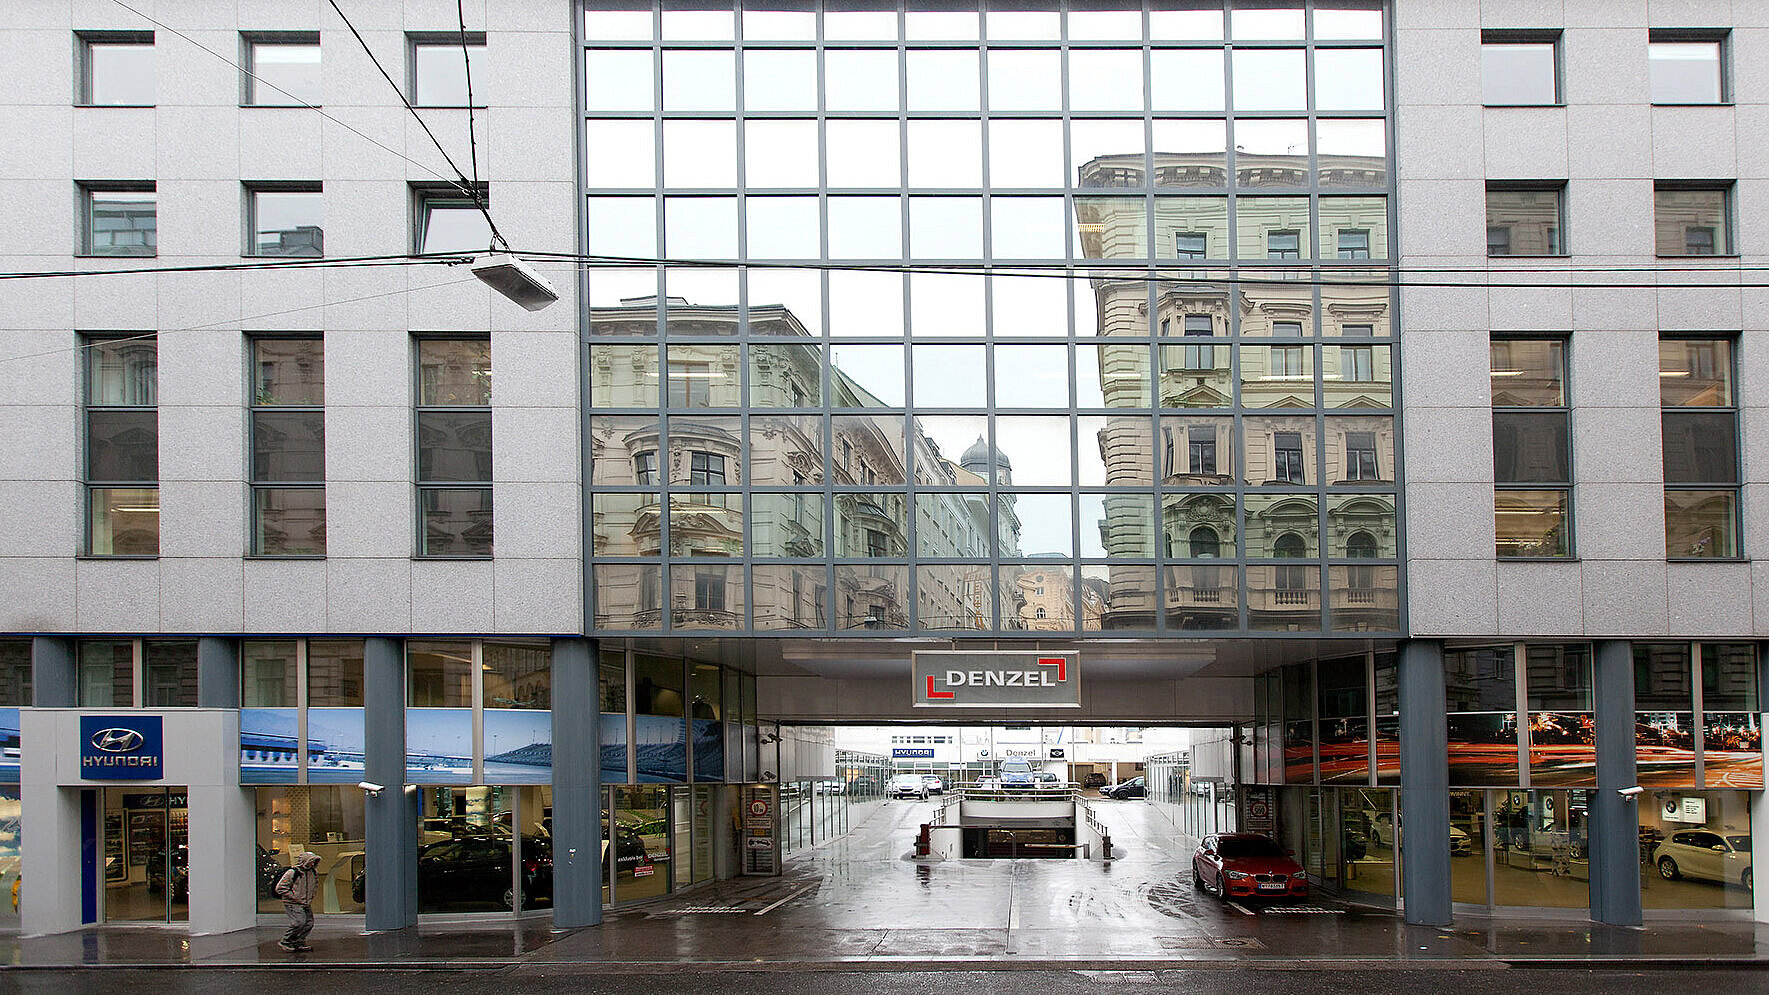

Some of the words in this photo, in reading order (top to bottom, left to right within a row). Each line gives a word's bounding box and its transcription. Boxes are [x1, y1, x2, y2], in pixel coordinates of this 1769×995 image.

[946, 670, 1056, 687] DENZEL
[894, 749, 933, 757] HYUNDAI
[1005, 749, 1036, 757] Denzel
[82, 755, 158, 767] HYUNDAI
[169, 796, 186, 805] HY
